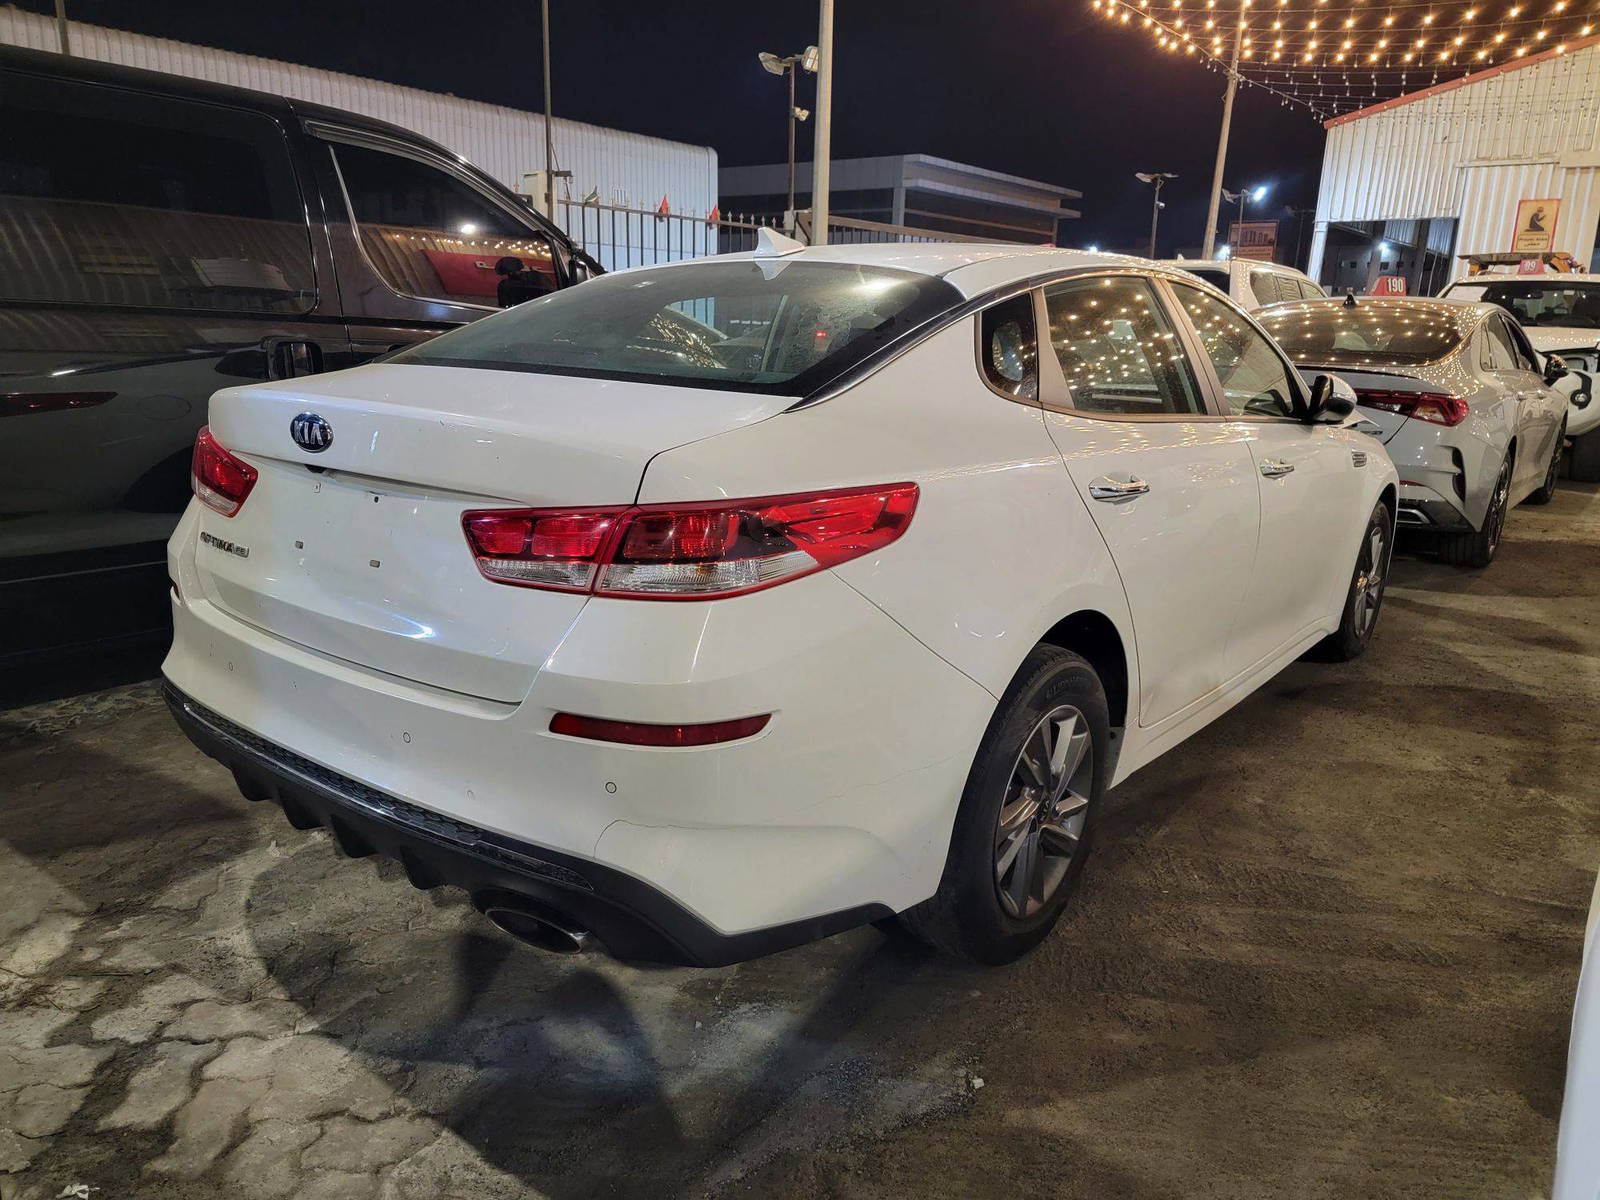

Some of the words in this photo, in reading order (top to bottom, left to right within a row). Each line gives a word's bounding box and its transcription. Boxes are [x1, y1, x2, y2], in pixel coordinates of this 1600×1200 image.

[1387, 278, 1404, 293] 190
[293, 419, 324, 446] KIA
[200, 531, 234, 553] OPTIMA
